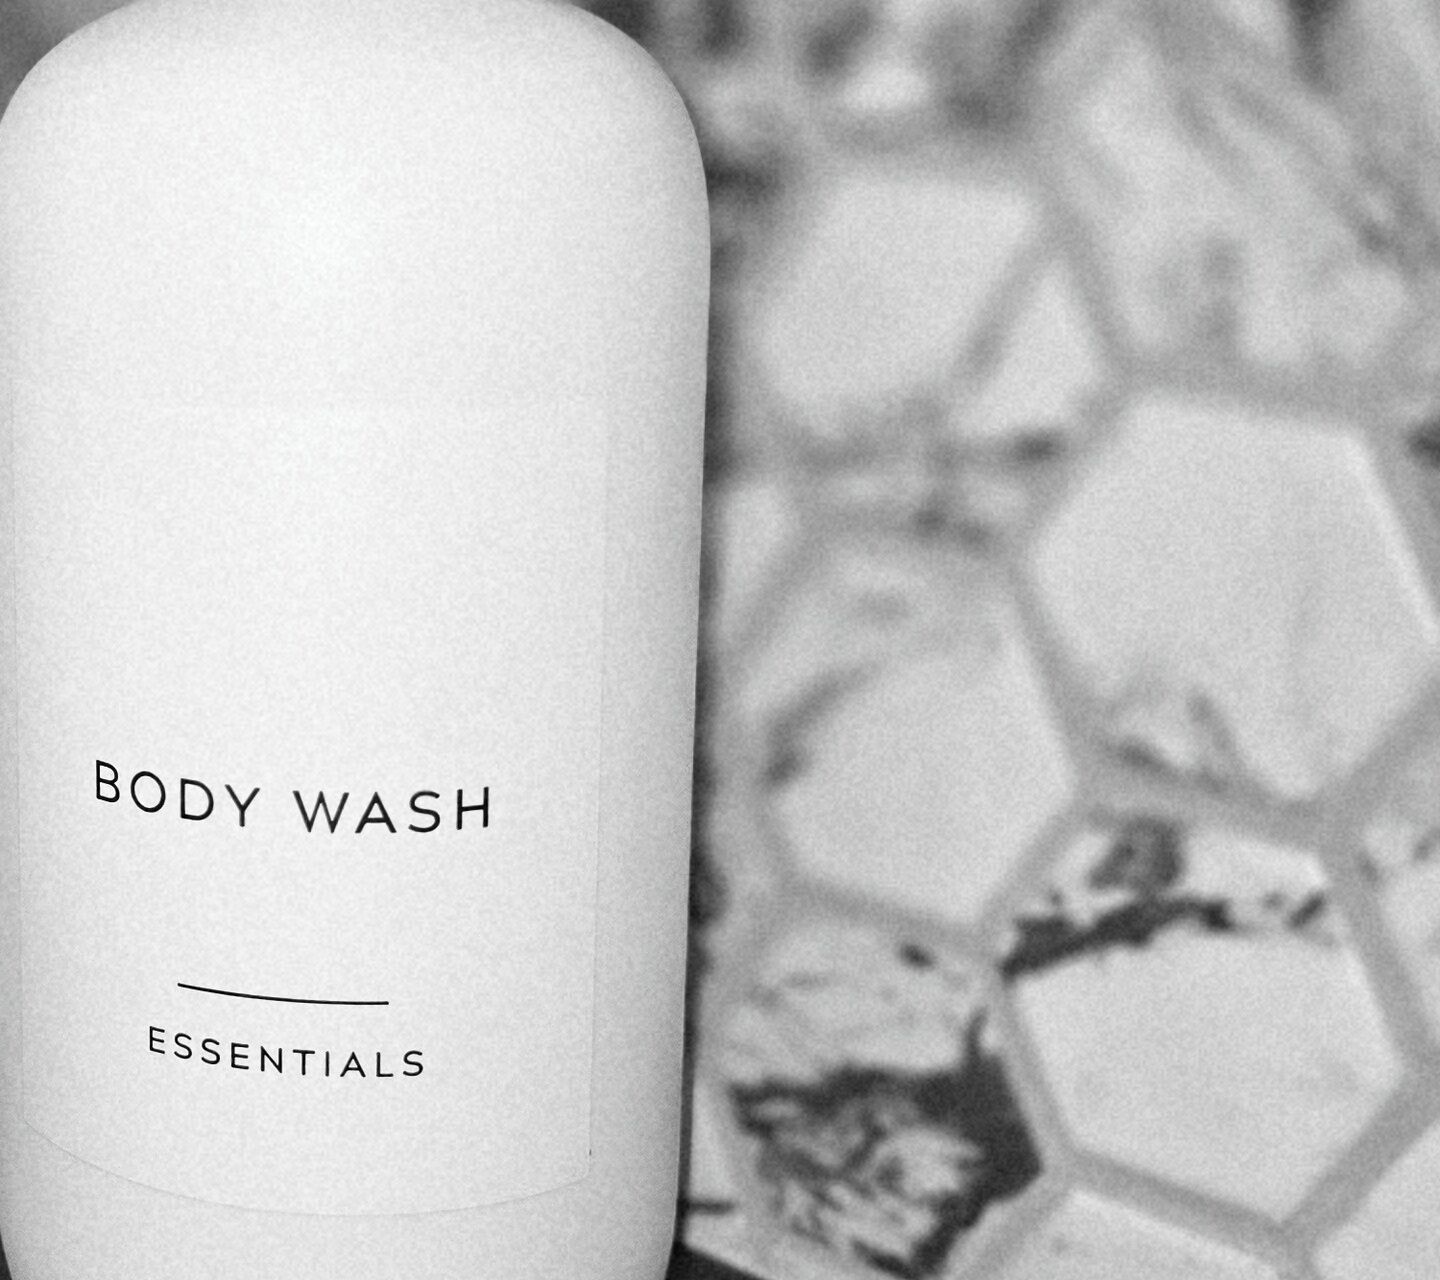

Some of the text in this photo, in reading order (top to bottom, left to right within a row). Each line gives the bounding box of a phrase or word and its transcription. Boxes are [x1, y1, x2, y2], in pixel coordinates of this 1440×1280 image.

[94, 759, 491, 834] BODY WASH
[148, 1025, 425, 1078] ESSENTIALS
